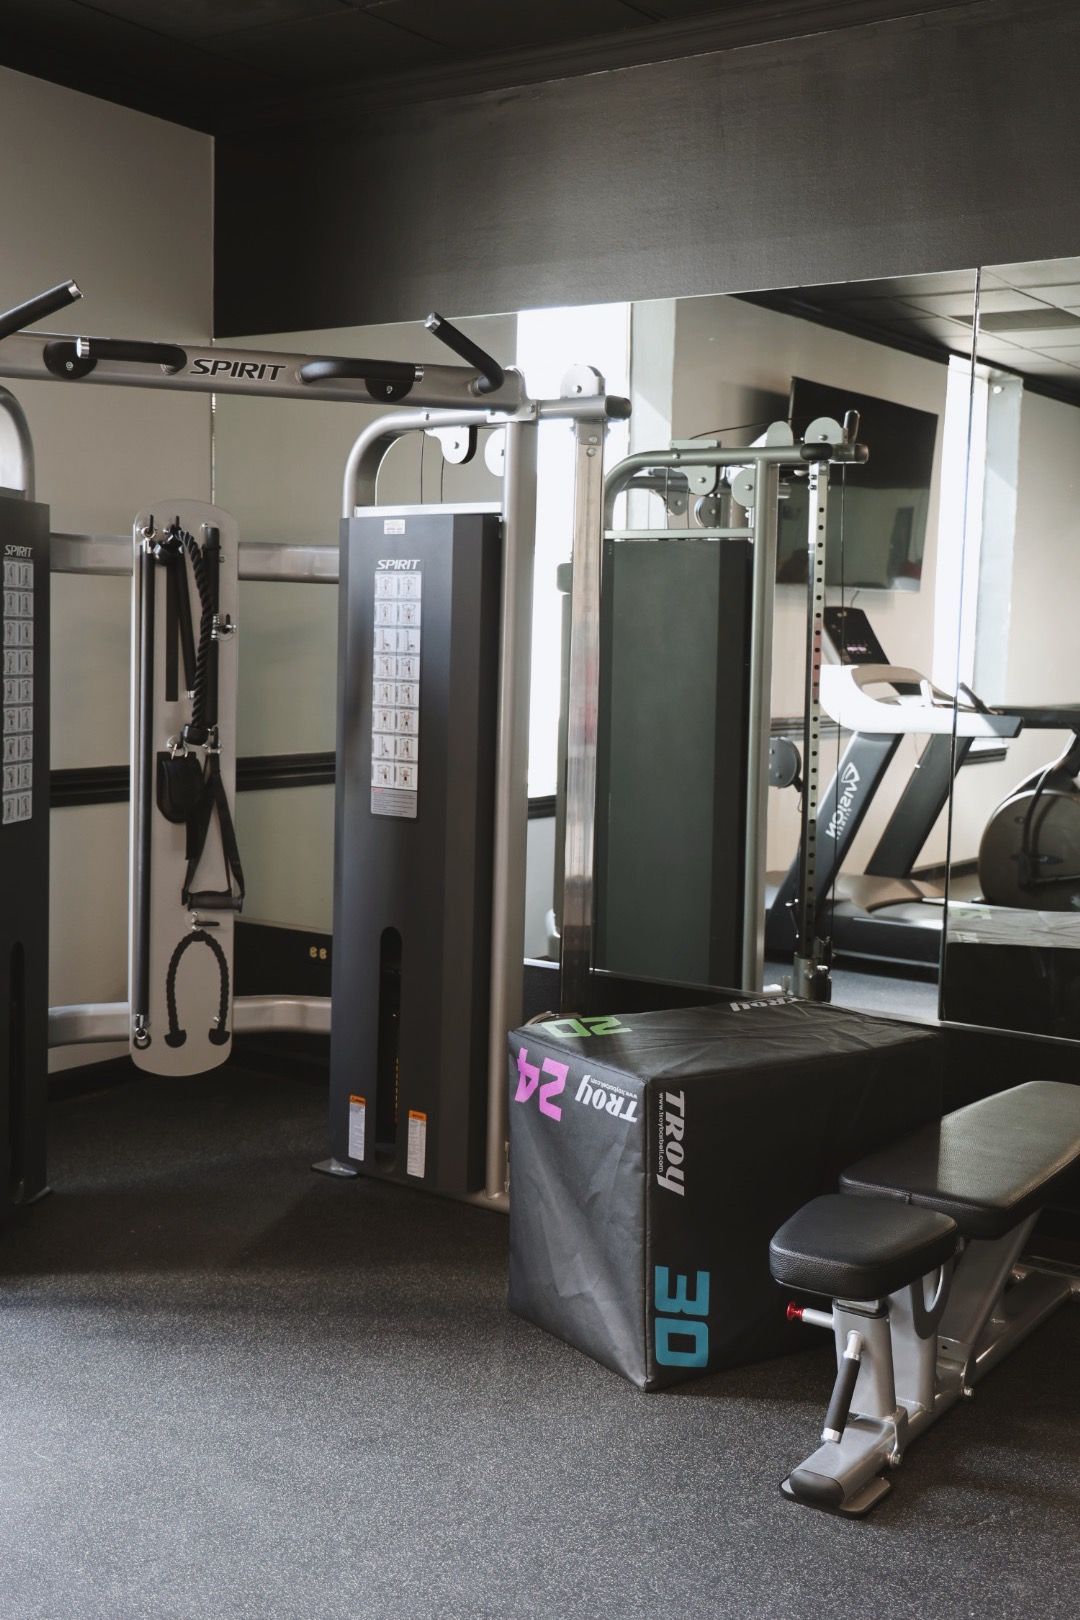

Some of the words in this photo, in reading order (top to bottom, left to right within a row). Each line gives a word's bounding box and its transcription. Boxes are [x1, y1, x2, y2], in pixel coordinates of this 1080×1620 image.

[189, 358, 286, 381] SPIRIT
[4, 544, 33, 558] SPIRIT
[376, 559, 421, 570] SPIRIT
[541, 1016, 632, 1038] 20
[514, 1047, 570, 1122] 24
[654, 1265, 710, 1368] 30
